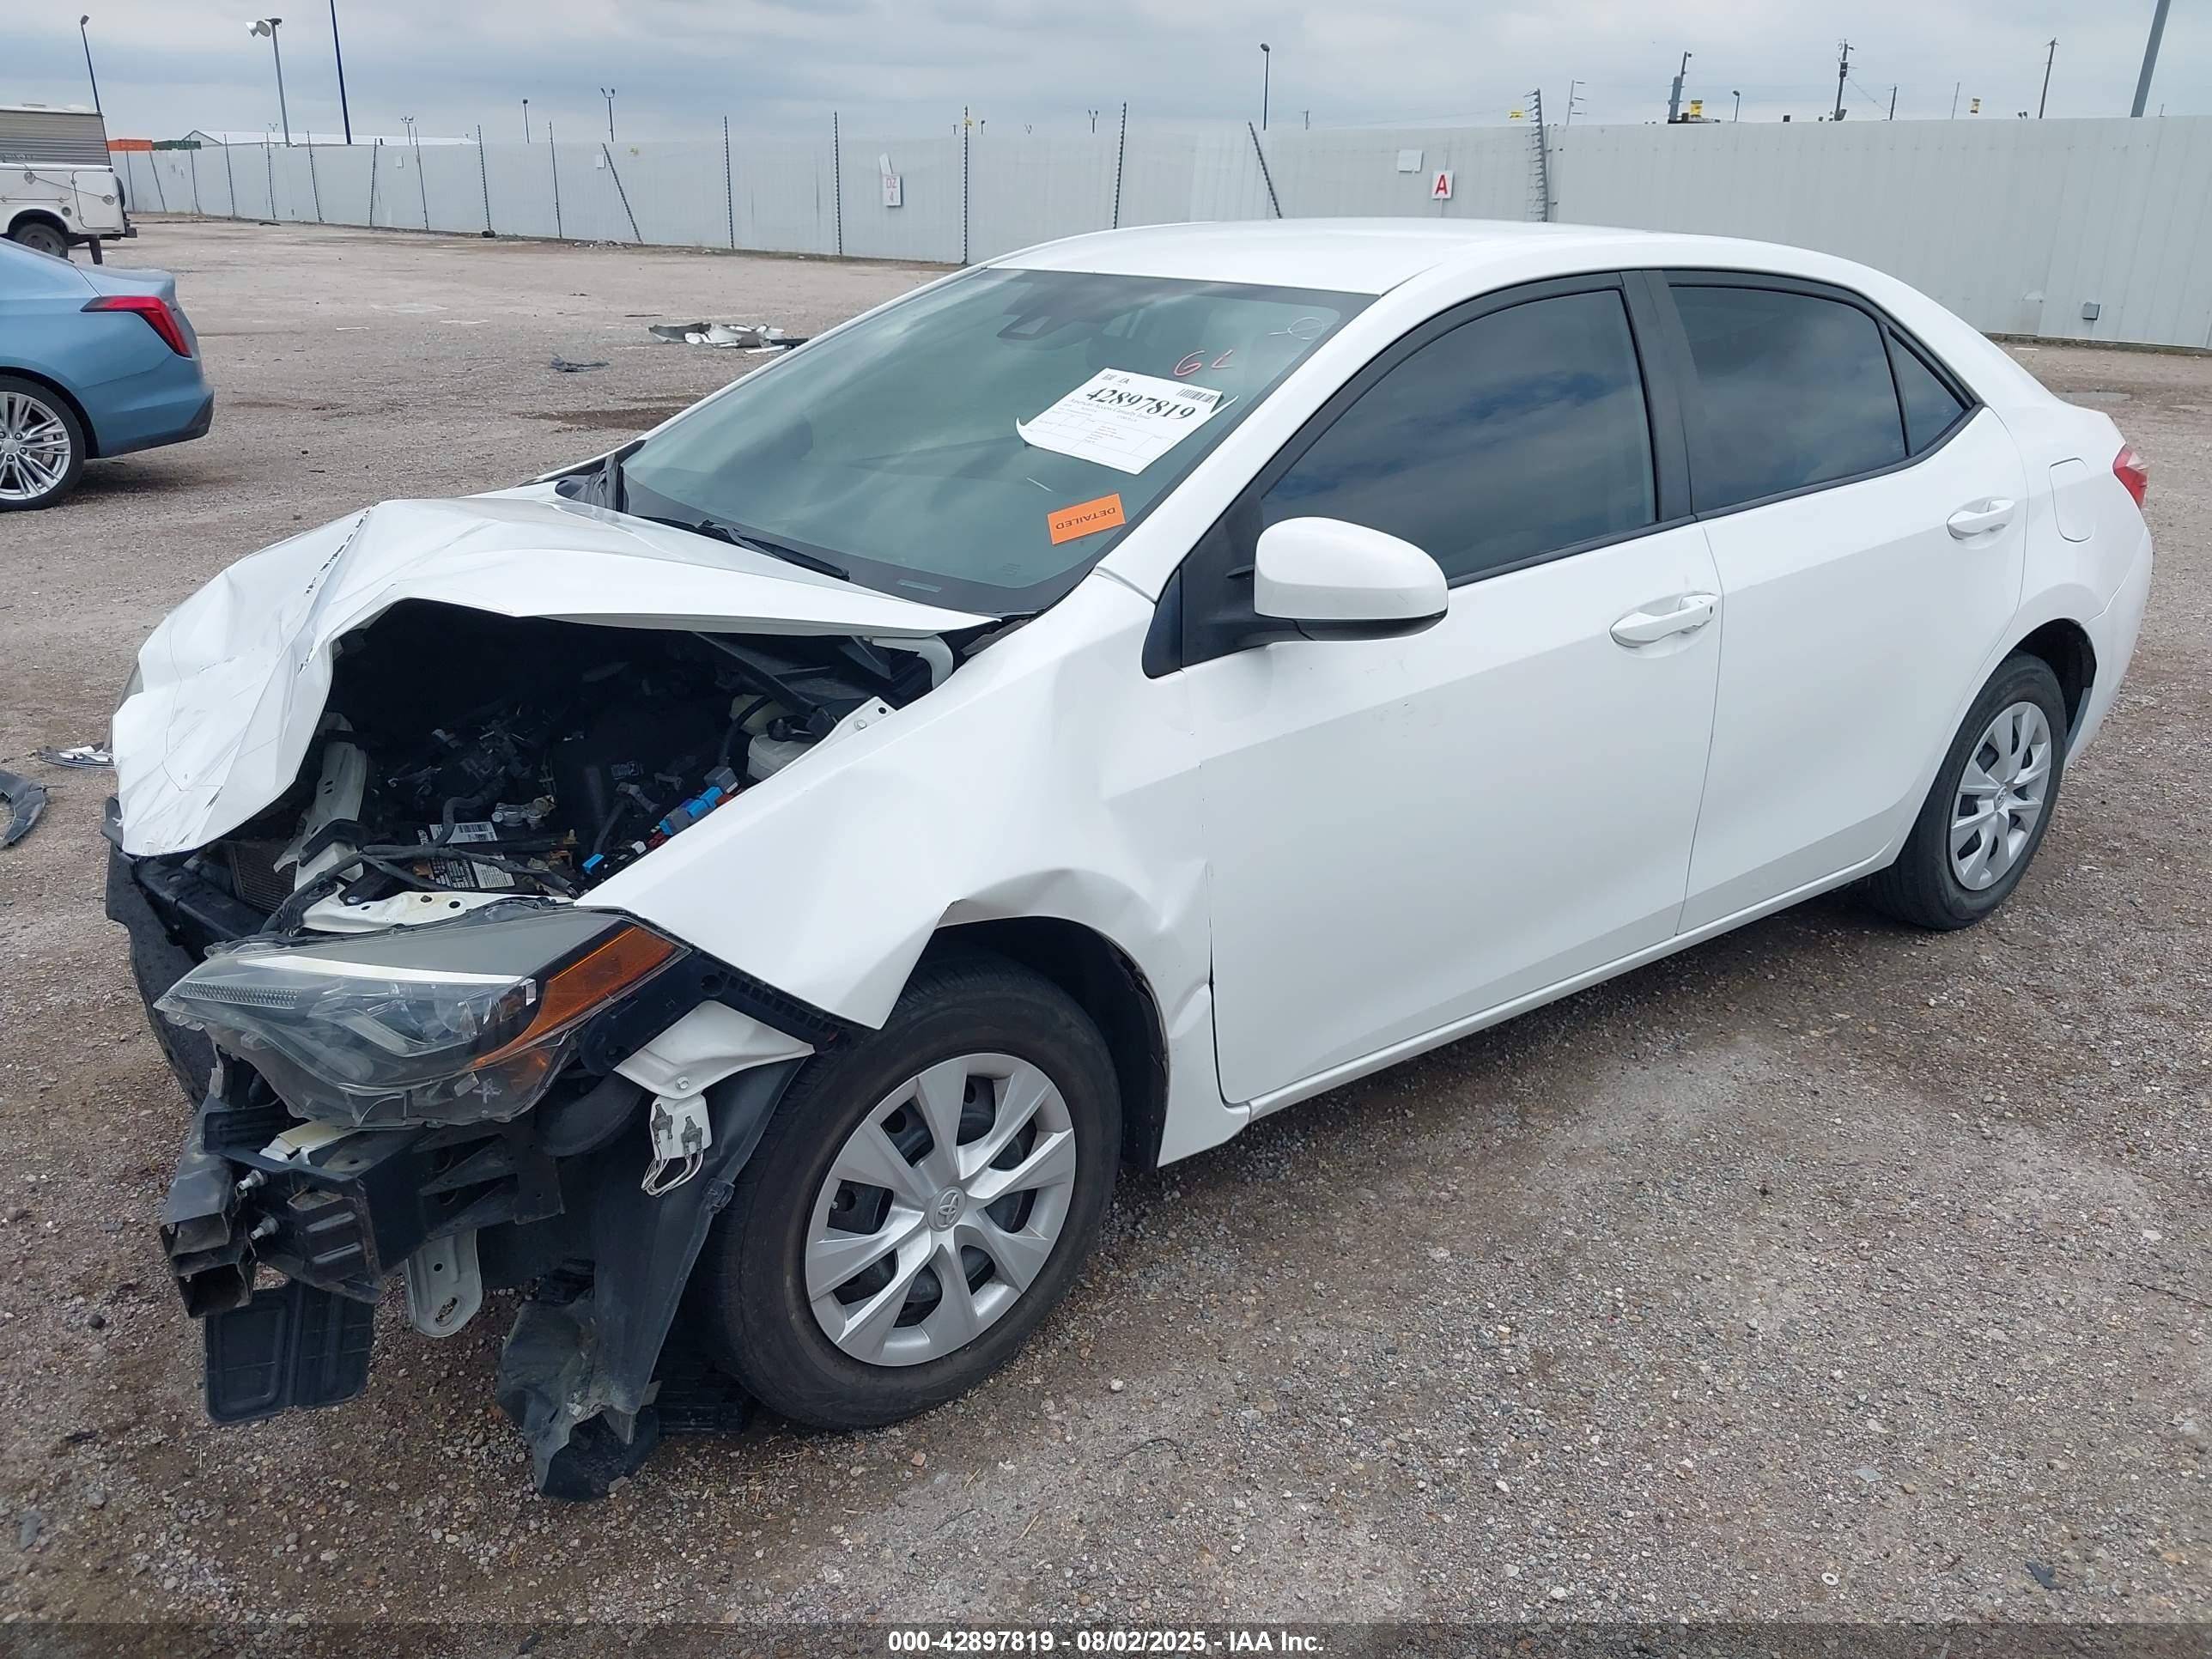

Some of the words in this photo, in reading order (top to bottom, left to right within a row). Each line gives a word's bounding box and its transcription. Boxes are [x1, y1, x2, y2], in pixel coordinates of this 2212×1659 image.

[1435, 174, 1448, 195] A
[1085, 387, 1196, 420] 42897819
[1055, 507, 1115, 530] DETAILED
